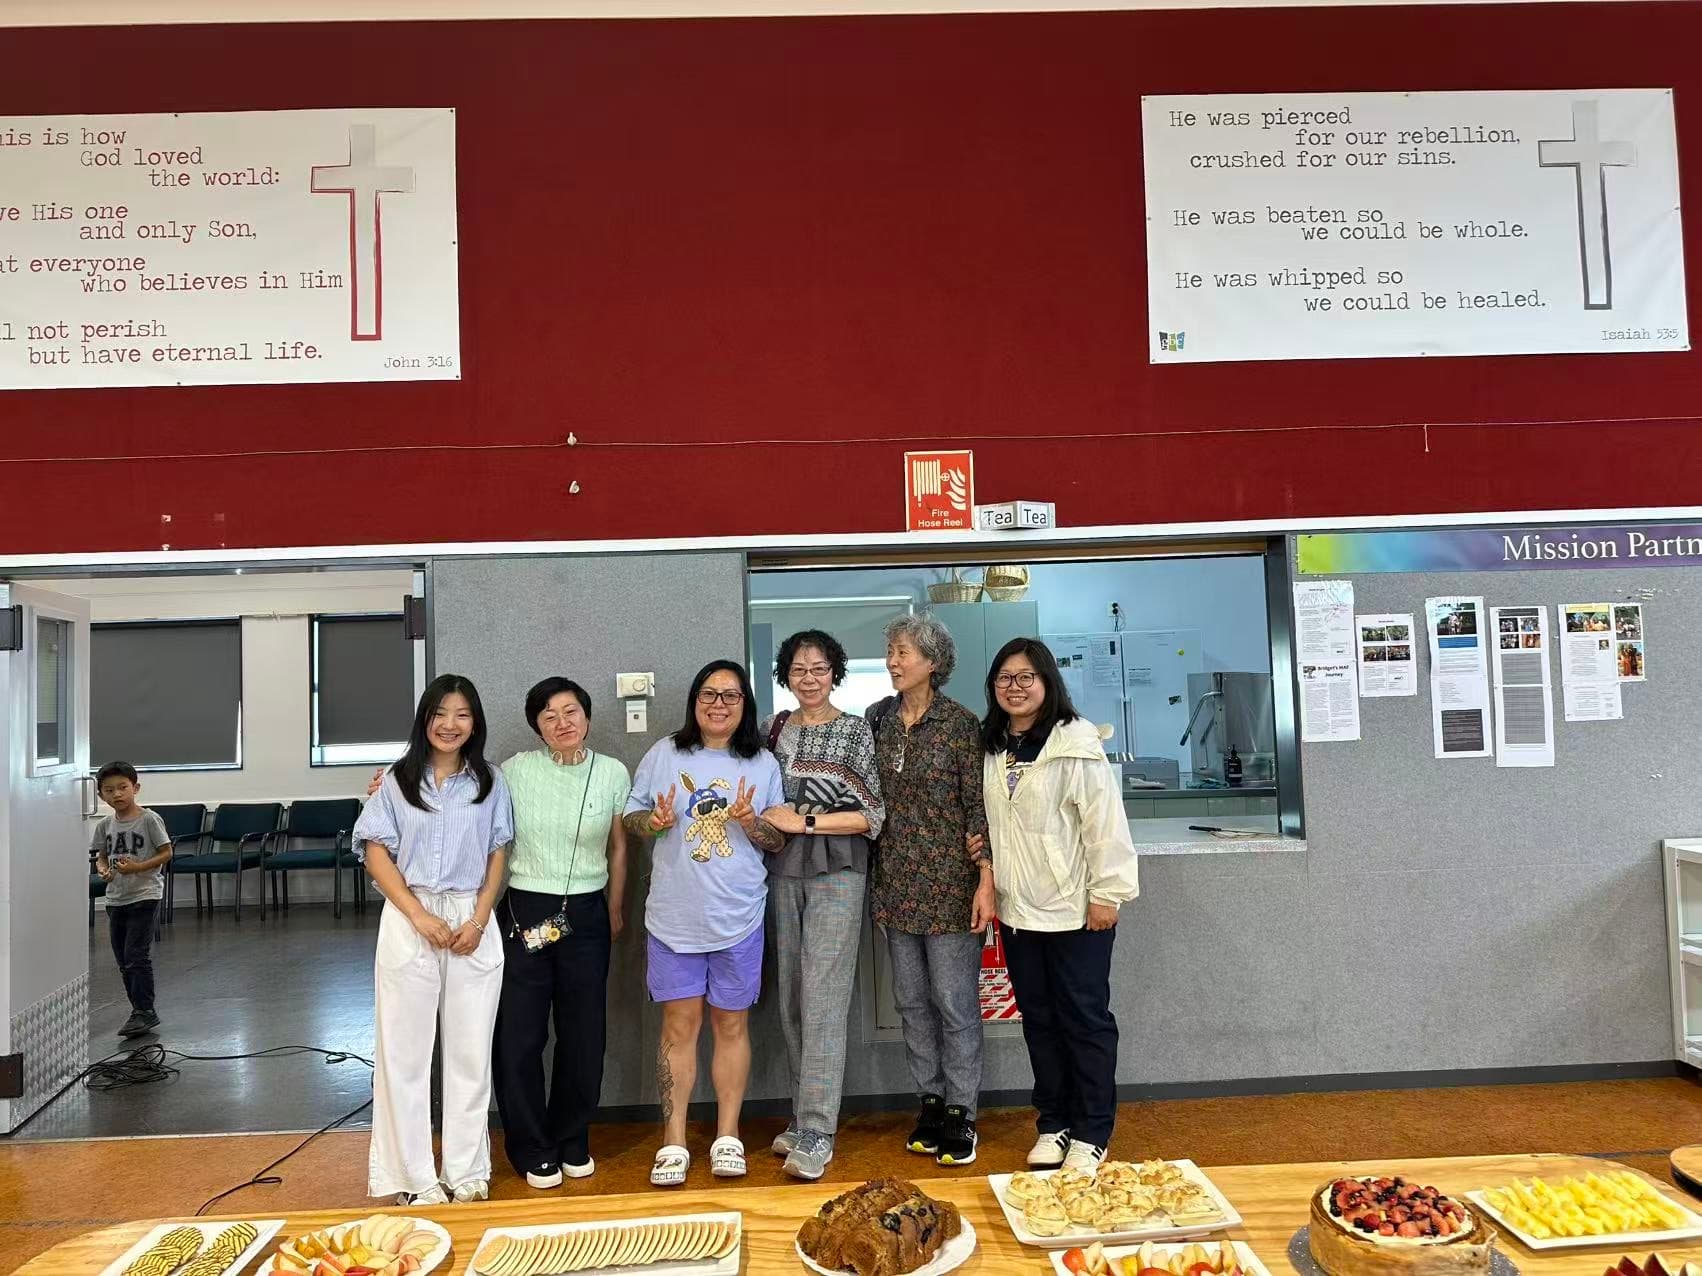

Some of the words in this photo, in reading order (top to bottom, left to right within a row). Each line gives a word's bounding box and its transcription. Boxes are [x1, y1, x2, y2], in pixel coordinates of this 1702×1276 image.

[1169, 111, 1196, 126] He
[1207, 113, 1250, 125] was
[1261, 107, 1352, 129] pierced
[43, 128, 69, 145] is
[81, 128, 126, 145] how
[1295, 129, 1335, 145] for
[1346, 132, 1387, 145] our
[1398, 126, 1520, 144] rebellion,
[81, 148, 122, 166] God
[134, 146, 204, 165] loved
[1190, 150, 1286, 168] crushed
[1296, 151, 1336, 167] for
[1345, 153, 1387, 166] our
[1398, 147, 1455, 165] sins.
[148, 169, 190, 186] the
[202, 167, 279, 186] world:
[32, 202, 73, 220] His
[85, 206, 128, 219] one
[1174, 210, 1200, 226] He
[1212, 211, 1255, 224] was
[1266, 206, 1347, 223] beaten
[1358, 210, 1383, 222] so
[80, 221, 126, 240] and
[137, 221, 196, 243] only
[208, 221, 256, 239] Son,
[1301, 227, 1328, 240] we
[1340, 222, 1407, 240] could
[1417, 222, 1443, 238] be
[1454, 221, 1528, 238] whole.
[30, 257, 145, 277] everyone
[81, 274, 126, 292] who
[138, 273, 247, 291] believes
[259, 271, 288, 289] in
[300, 270, 343, 288] Him
[1176, 272, 1202, 288] He
[1214, 274, 1257, 287] was
[1268, 267, 1366, 289] whipped
[1377, 271, 1403, 284] so
[1304, 298, 1331, 311] we
[1343, 292, 1410, 310] could
[1421, 292, 1446, 309] be
[1457, 290, 1546, 308] healed.
[0, 322, 16, 341] l
[27, 320, 69, 340] not
[81, 320, 167, 343] perish
[1601, 328, 1651, 340] Isaiah
[1656, 328, 1680, 340] 53:5
[28, 346, 70, 364] but
[81, 346, 141, 364] have
[152, 343, 253, 361] eternal
[264, 341, 322, 359] life.
[384, 356, 421, 368] John
[427, 355, 453, 368] 3:16
[918, 519, 941, 528] Hose
[944, 518, 963, 527] Reel
[931, 509, 949, 517] Fire
[984, 511, 1012, 525] Tea
[1023, 508, 1047, 524] Tea
[1502, 534, 1618, 560] Mission
[1627, 532, 1702, 557] Partn
